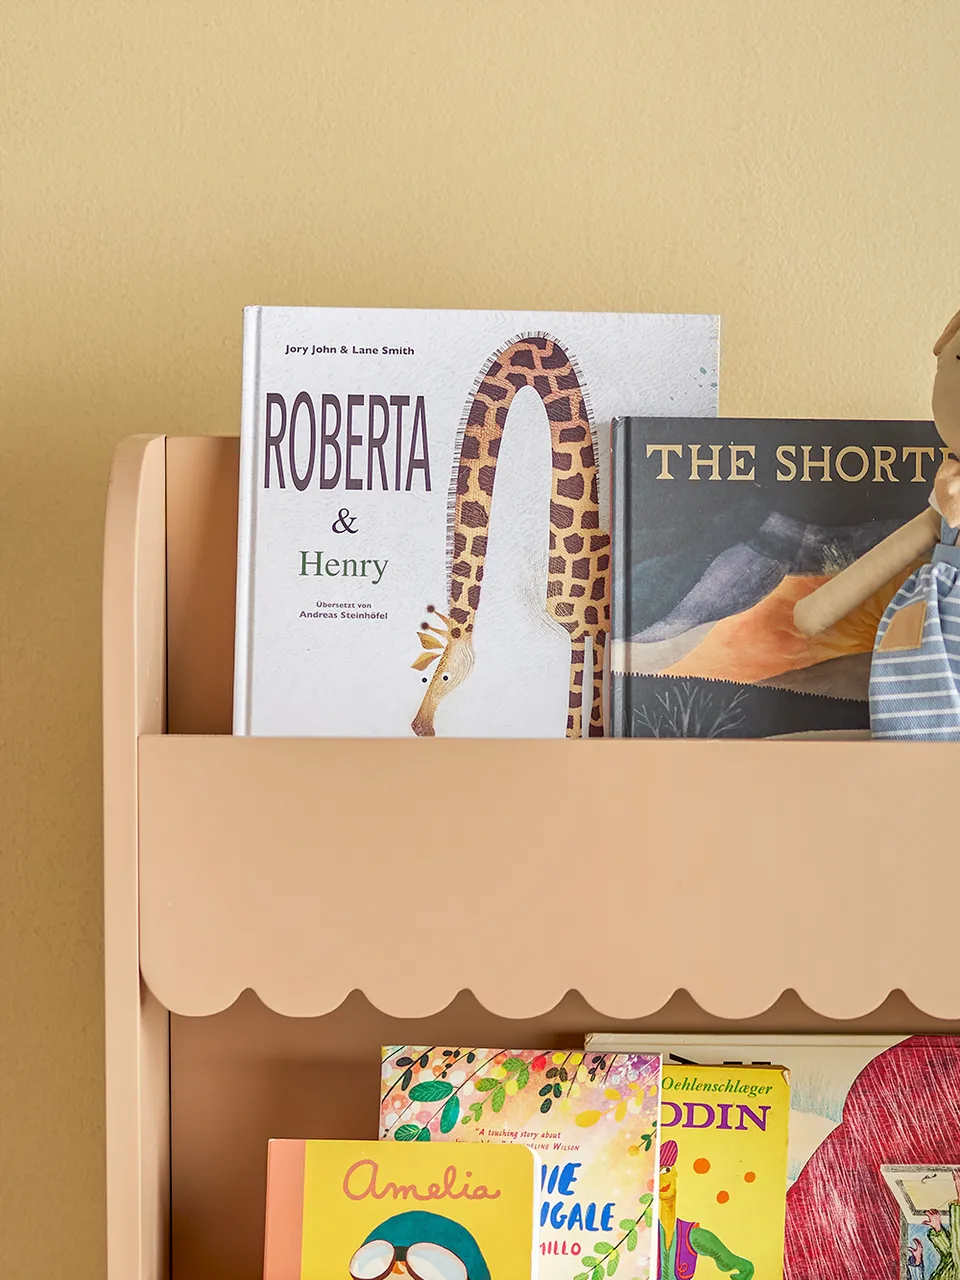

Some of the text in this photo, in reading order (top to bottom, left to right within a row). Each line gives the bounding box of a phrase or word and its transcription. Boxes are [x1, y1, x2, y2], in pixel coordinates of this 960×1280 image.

[285, 344, 415, 355] Jory John & Lane Smith
[263, 391, 432, 492] ROBERTA
[645, 444, 757, 482] THE
[776, 444, 957, 484] SHORT
[331, 507, 359, 534] &
[299, 550, 390, 585] Henry
[299, 610, 388, 620] Andreas Steinhöfel
[316, 600, 355, 609] Übersetzt
[661, 1101, 771, 1131] DDIN
[488, 1128, 518, 1139] touching
[520, 1130, 539, 1140] story
[541, 1131, 561, 1139] about
[343, 1158, 502, 1202] Amelia
